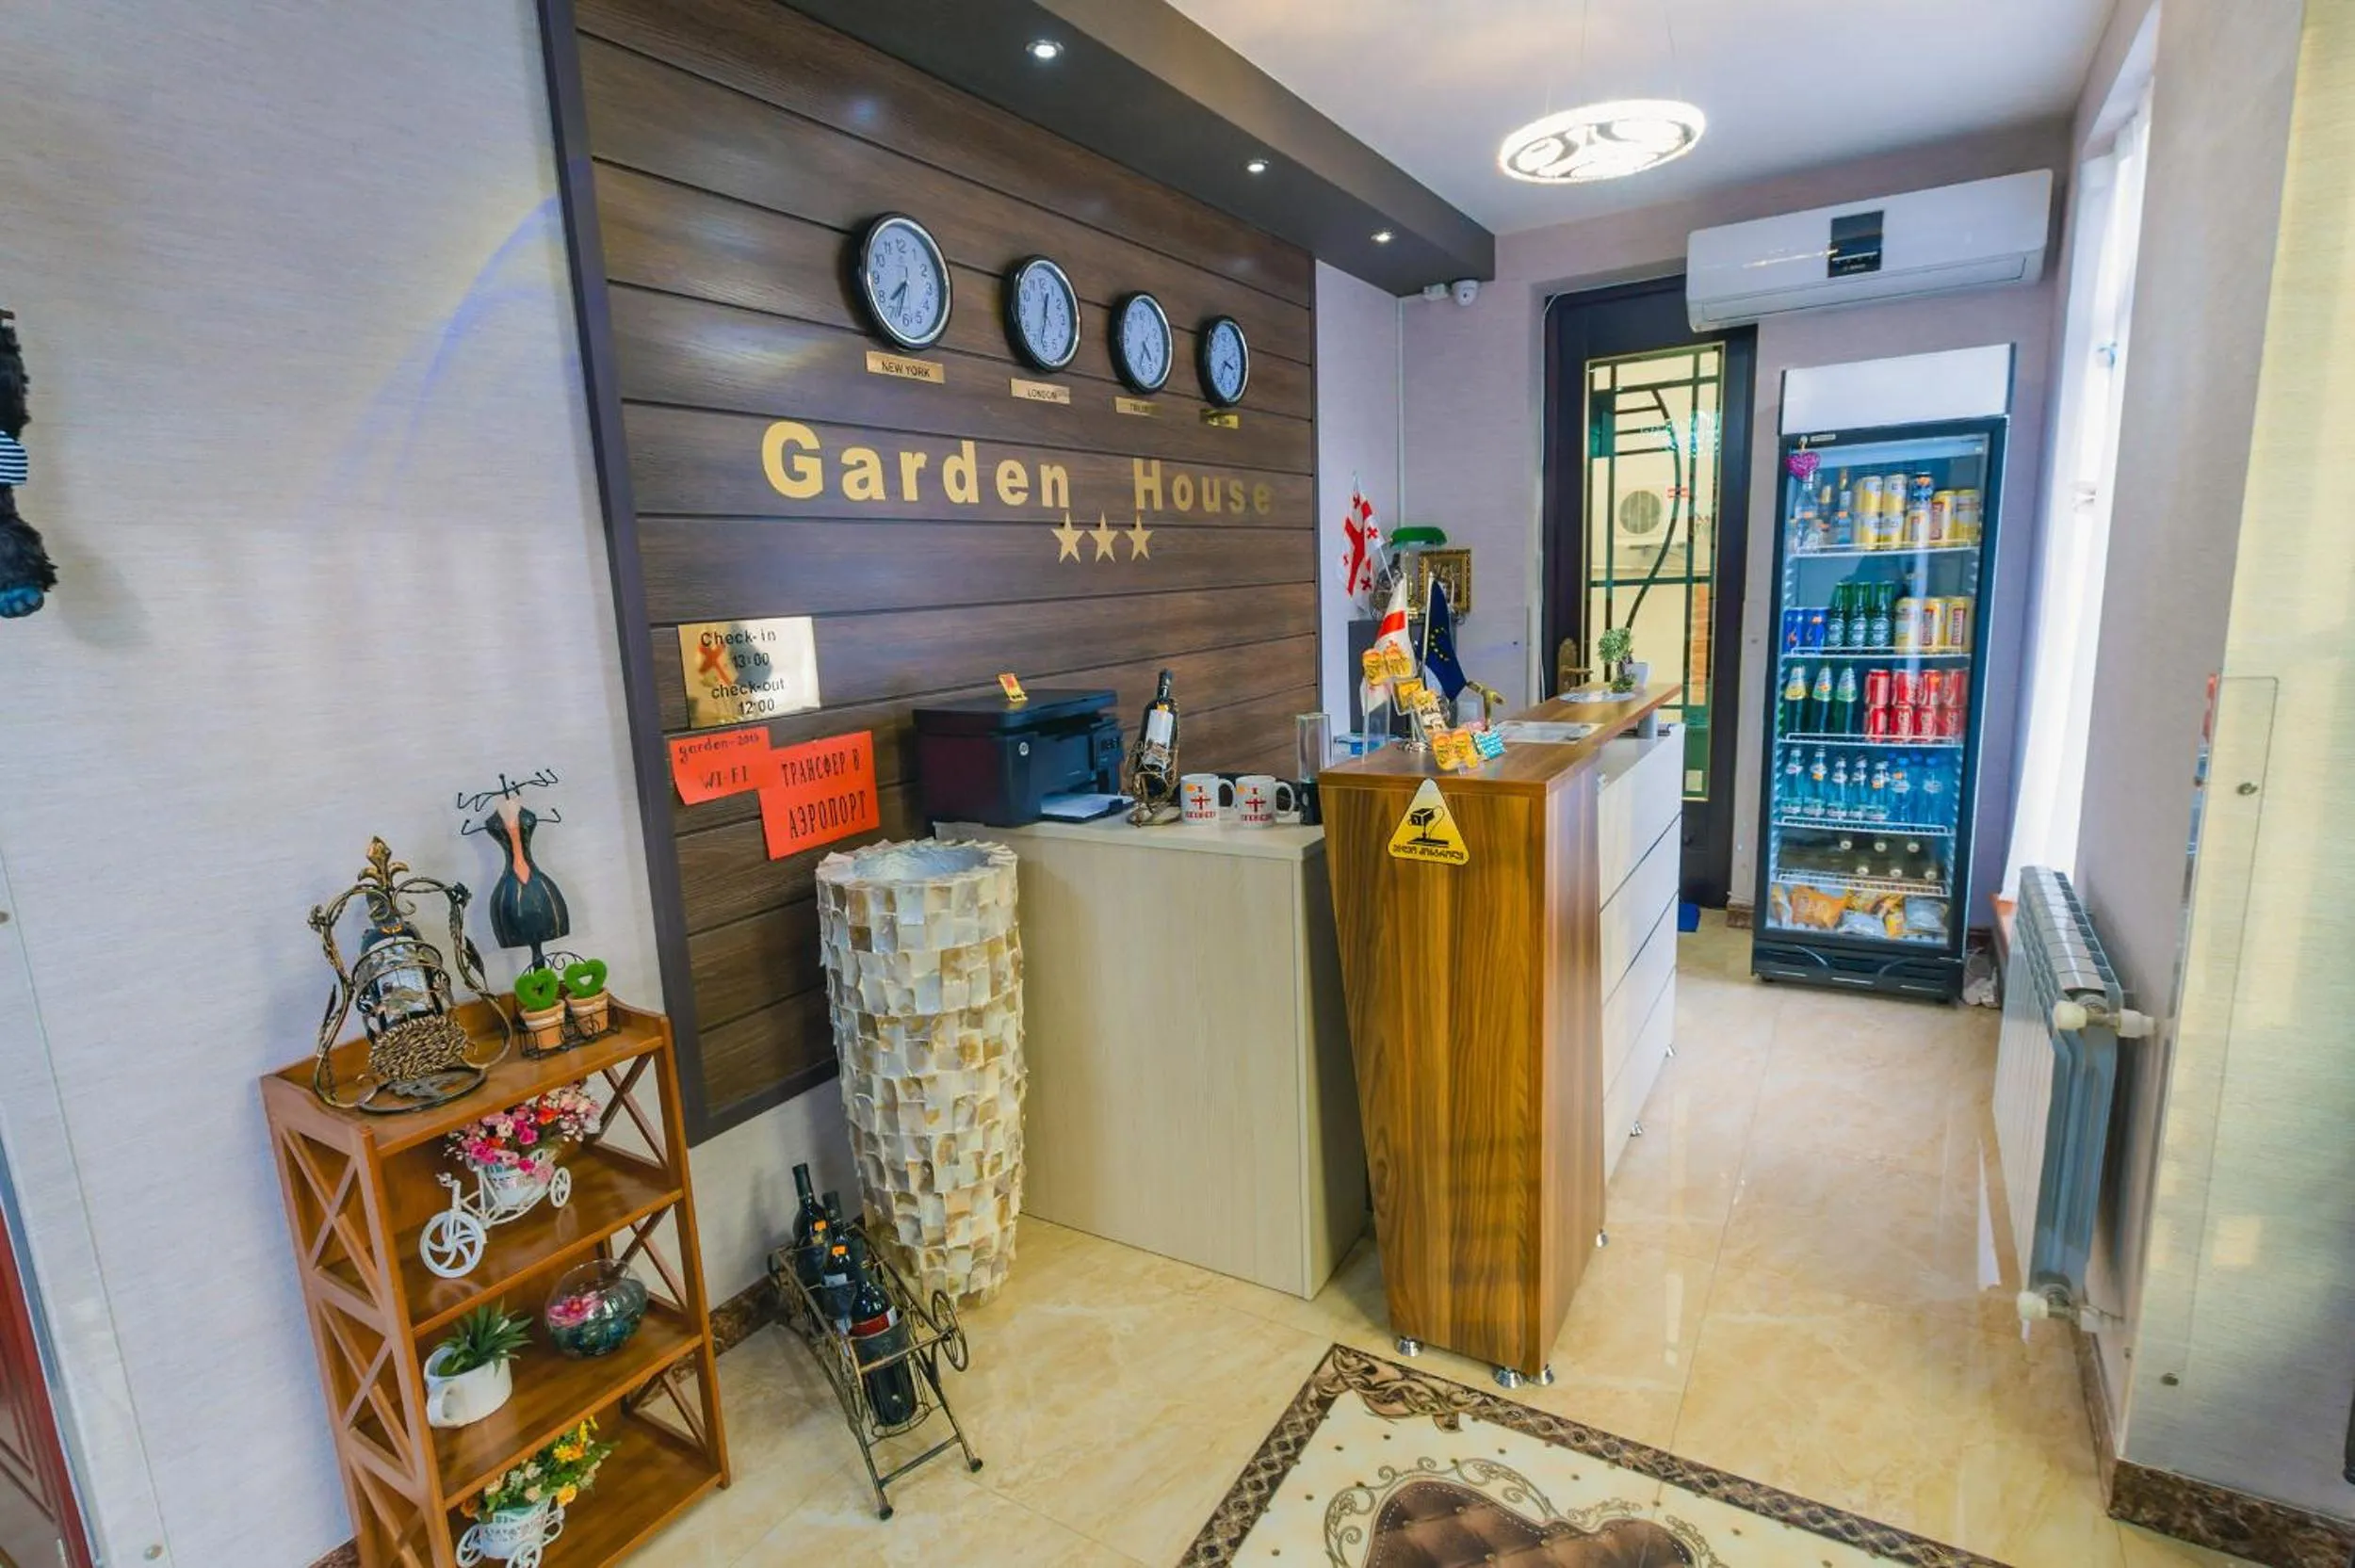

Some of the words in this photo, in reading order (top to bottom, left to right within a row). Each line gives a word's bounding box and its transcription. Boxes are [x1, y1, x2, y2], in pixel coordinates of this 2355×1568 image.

[919, 263, 928, 277] 2
[881, 361, 903, 374] NEW
[905, 363, 931, 378] YORK
[1027, 387, 1058, 400] LONDON
[760, 420, 1071, 510] Garden
[1132, 457, 1275, 515] House
[711, 678, 785, 700] check-out
[739, 698, 776, 715] 12:00
[781, 751, 846, 787] ТРАНСФЕР
[788, 790, 867, 839] АЭРОПОРТ
